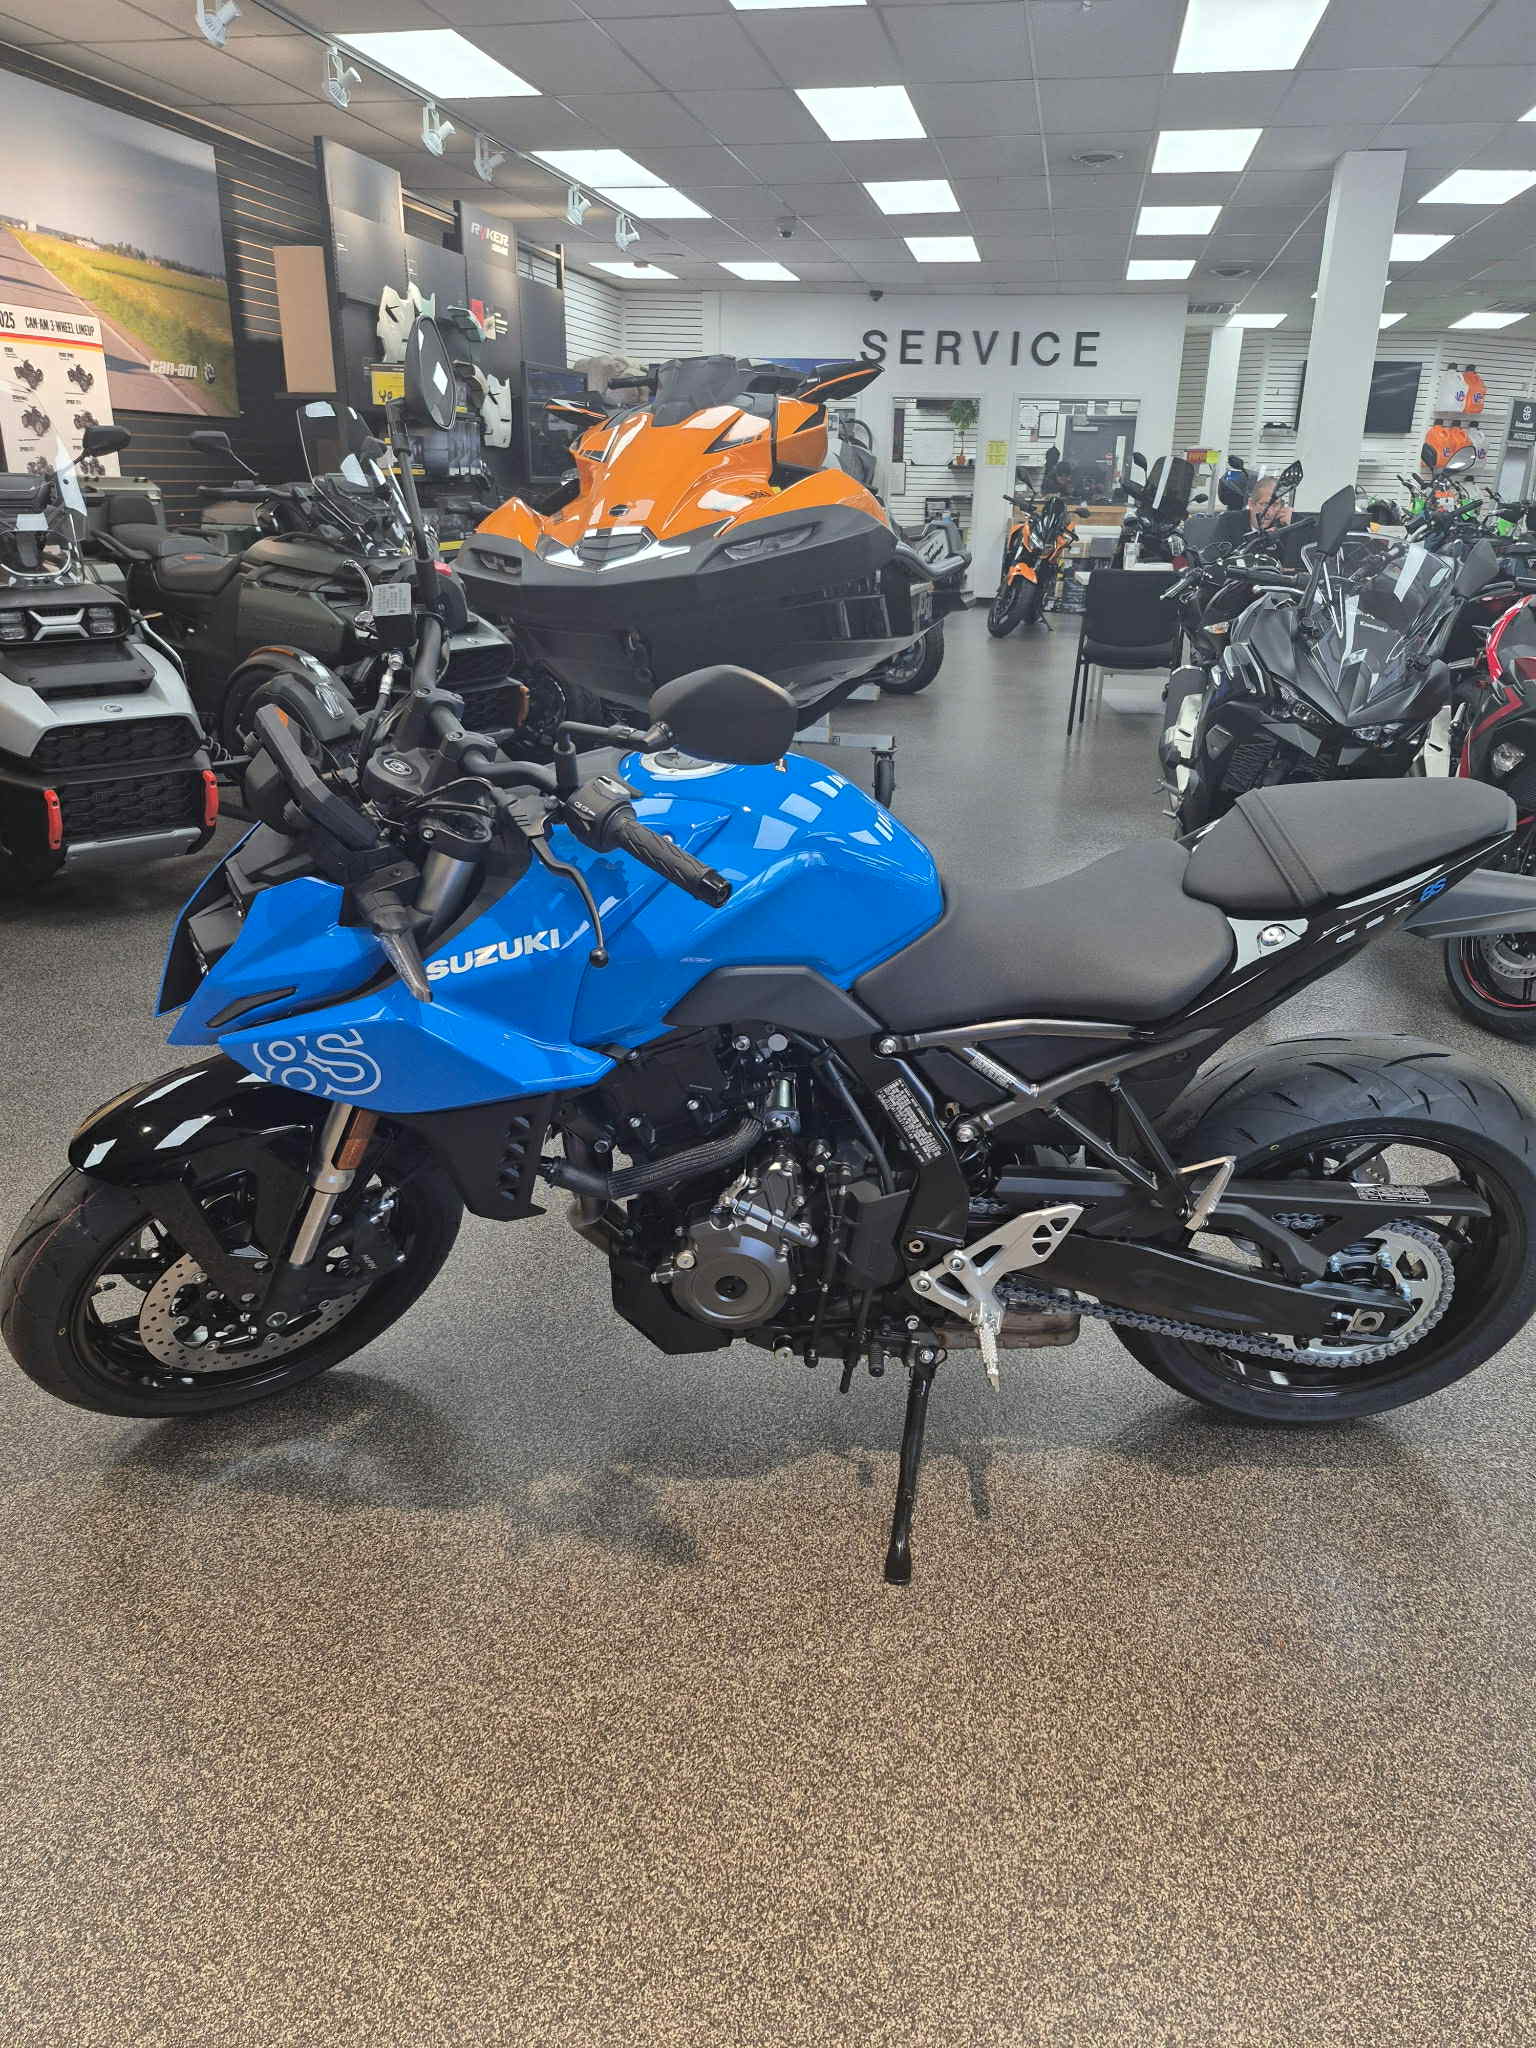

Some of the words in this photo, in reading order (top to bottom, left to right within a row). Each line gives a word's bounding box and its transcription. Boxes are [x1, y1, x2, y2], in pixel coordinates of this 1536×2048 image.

[860, 329, 1100, 367] SERVICE
[149, 360, 198, 377] can-am
[425, 928, 561, 981] SUZUKI
